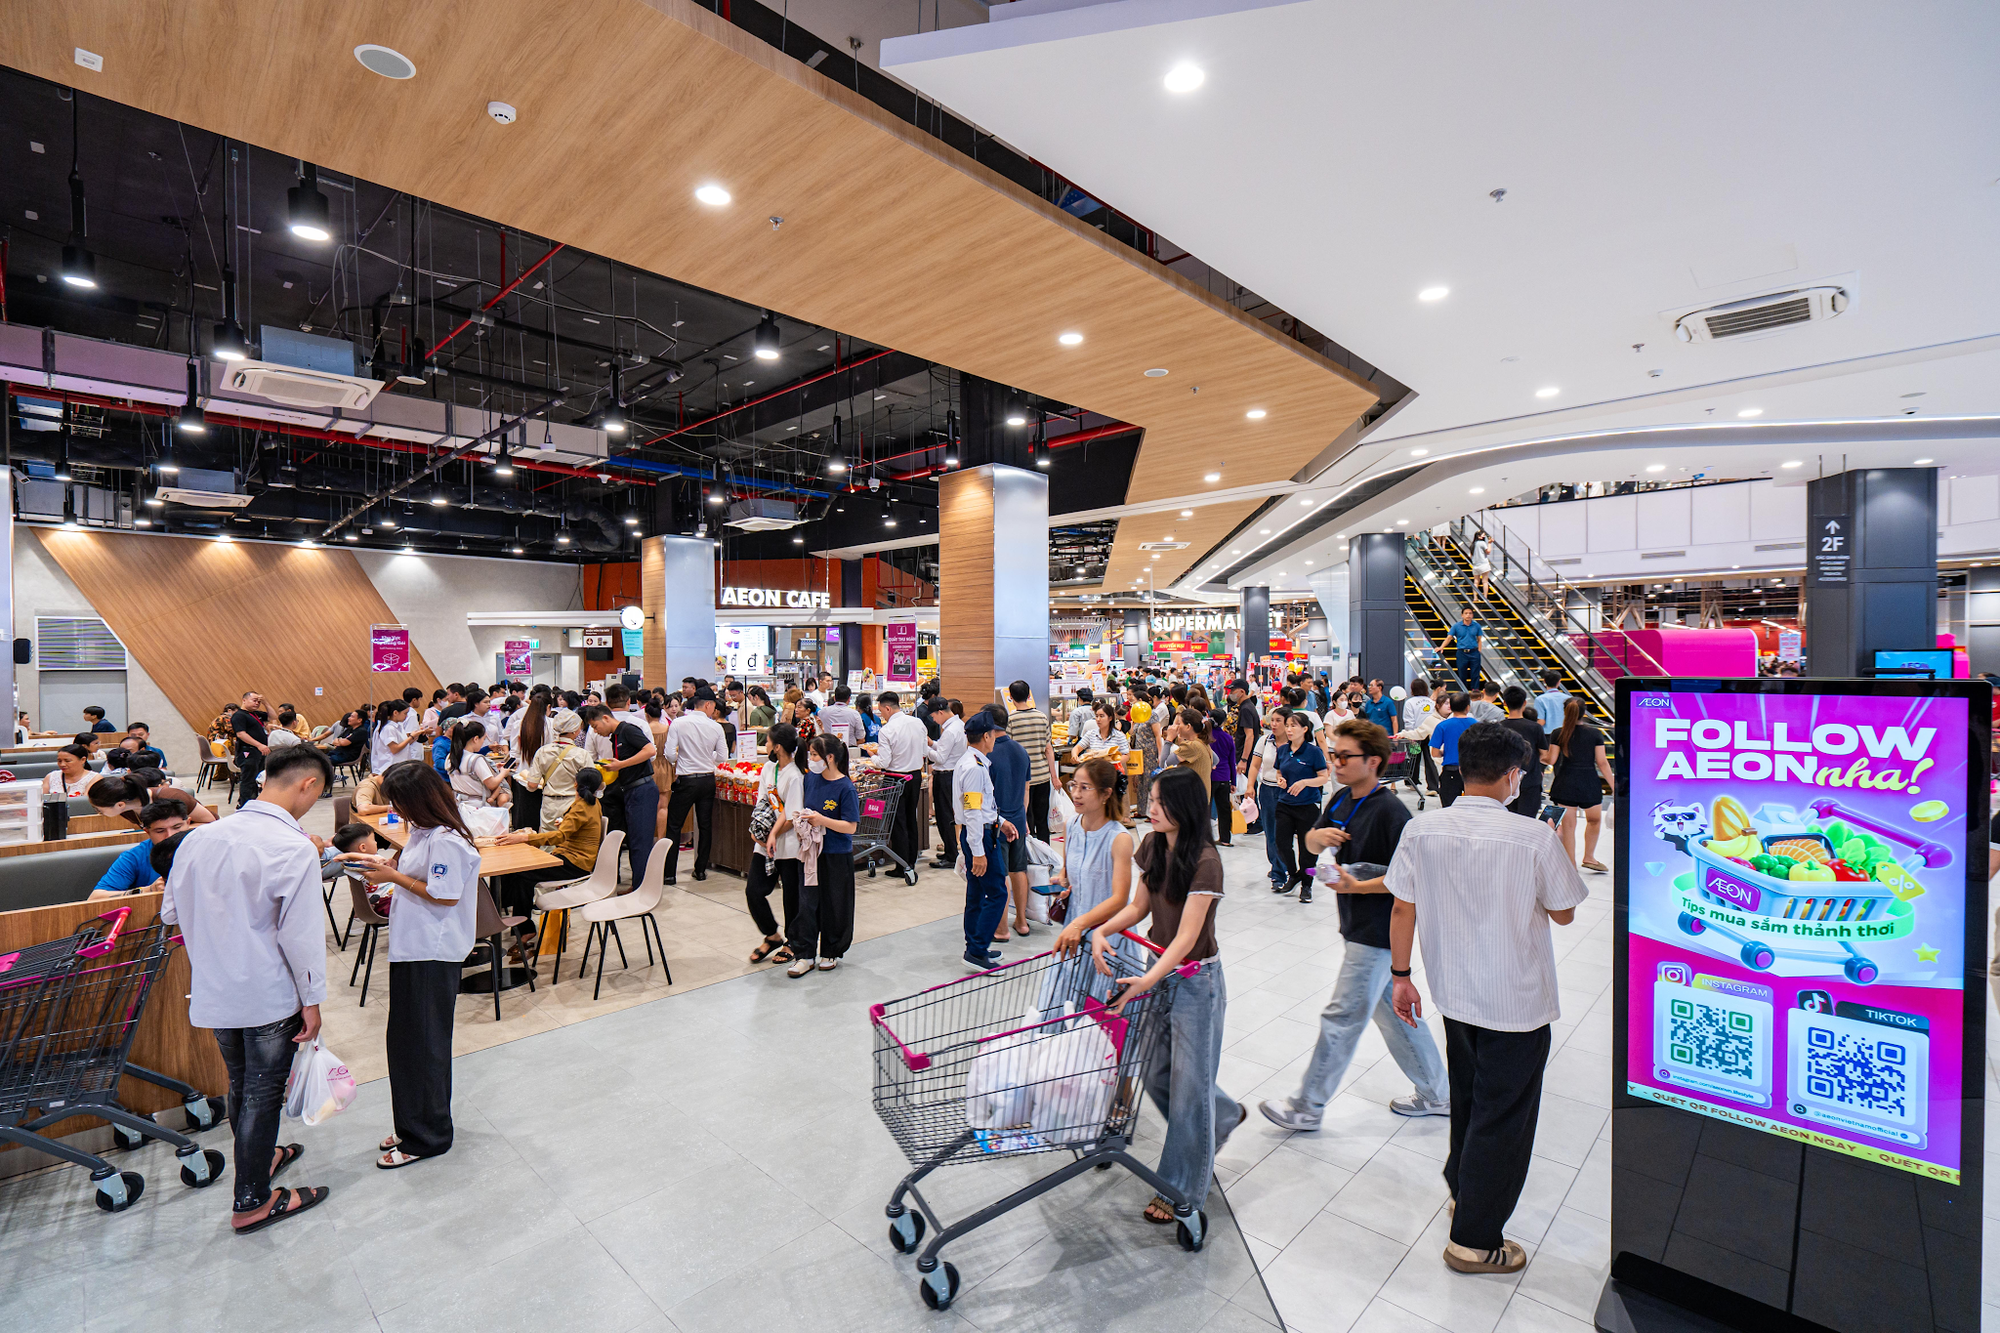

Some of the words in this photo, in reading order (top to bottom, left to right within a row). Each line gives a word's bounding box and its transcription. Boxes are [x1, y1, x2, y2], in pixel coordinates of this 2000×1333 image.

[1821, 536, 1845, 552] 2F
[721, 587, 781, 607] AEON
[786, 590, 831, 609] CAFE
[1655, 718, 1938, 761] FOLLOW
[1655, 751, 1818, 784] AEON
[1815, 757, 1935, 795] nha!
[1682, 896, 1706, 918] Tips
[1709, 910, 1746, 927] mua
[1750, 916, 1789, 935] sắm
[1793, 921, 1852, 938] thảnh
[1857, 921, 1895, 936] thơi
[1702, 978, 1768, 997] INSTAGRAM
[1866, 1009, 1917, 1027] TIKTOK
[1814, 1110, 1898, 1136] @aeonvietnamofficial
[1689, 1102, 1708, 1112] QR
[1710, 1107, 1767, 1128] FOLLOW
[1770, 1124, 1810, 1140] AEON
[1813, 1132, 1857, 1152] NGAY
[1927, 1166, 1951, 1179] QR
